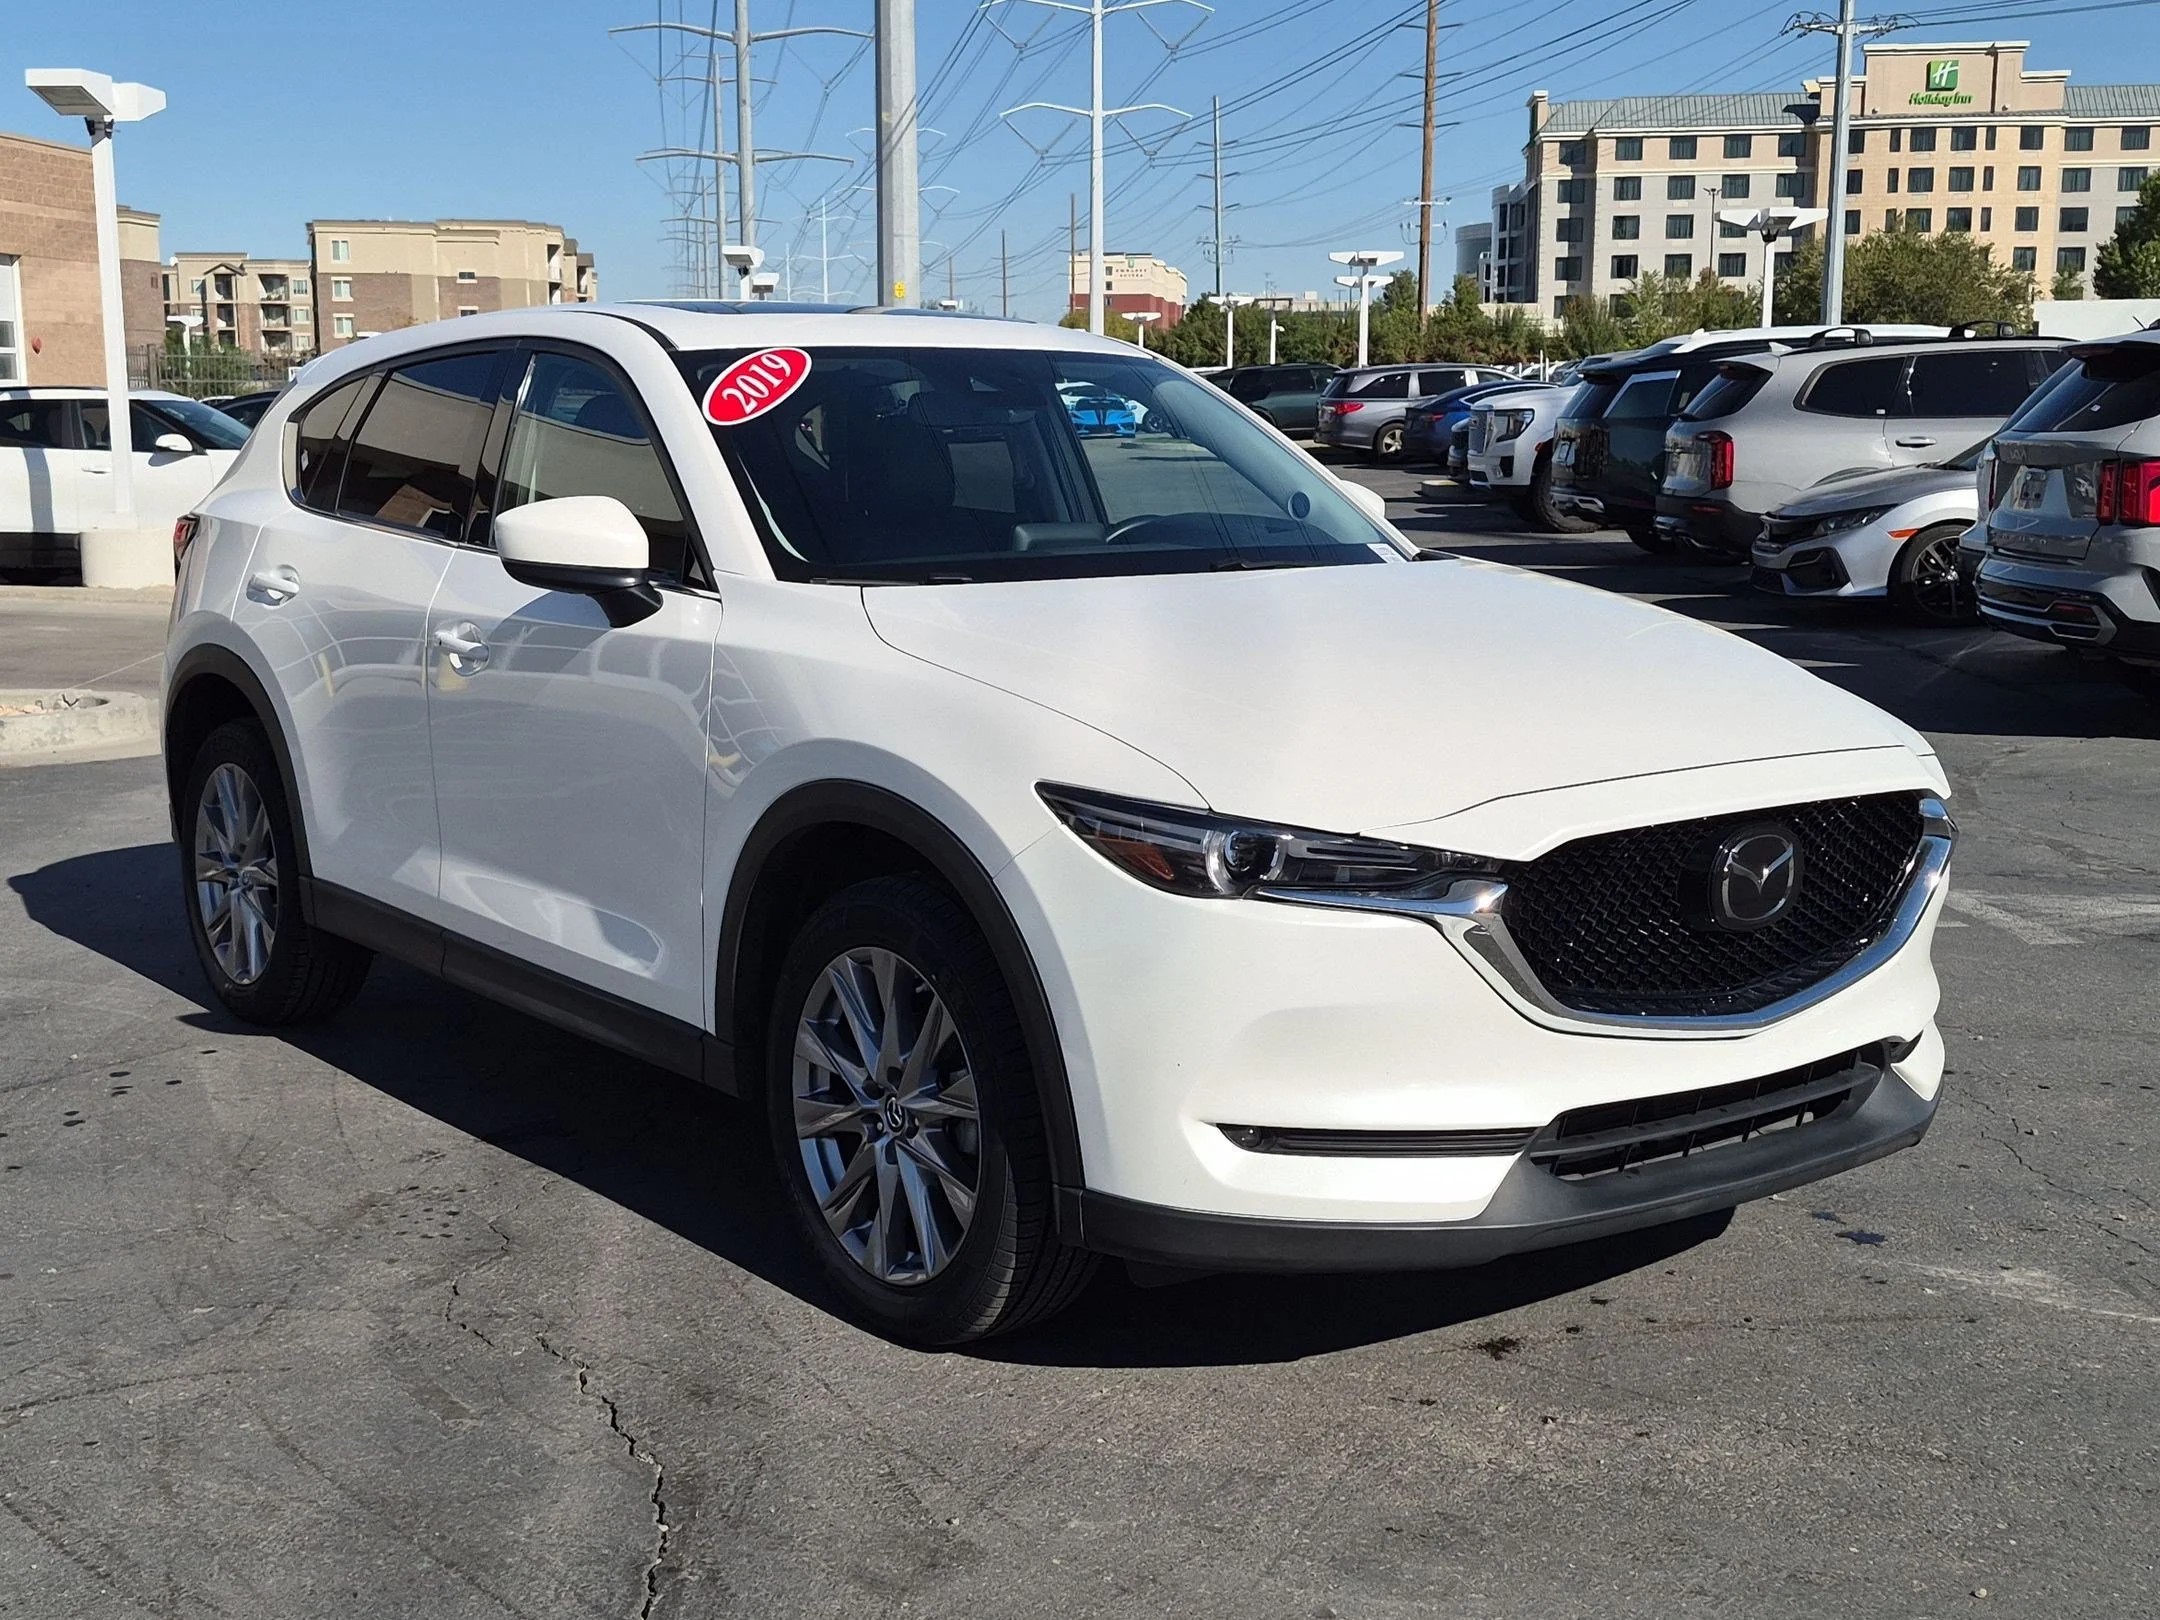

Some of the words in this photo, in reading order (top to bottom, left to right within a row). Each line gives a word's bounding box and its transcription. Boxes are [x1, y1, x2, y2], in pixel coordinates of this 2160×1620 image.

[1908, 92, 1953, 107] Holiday
[1953, 92, 1973, 104] Inn
[721, 353, 792, 415] 2019
